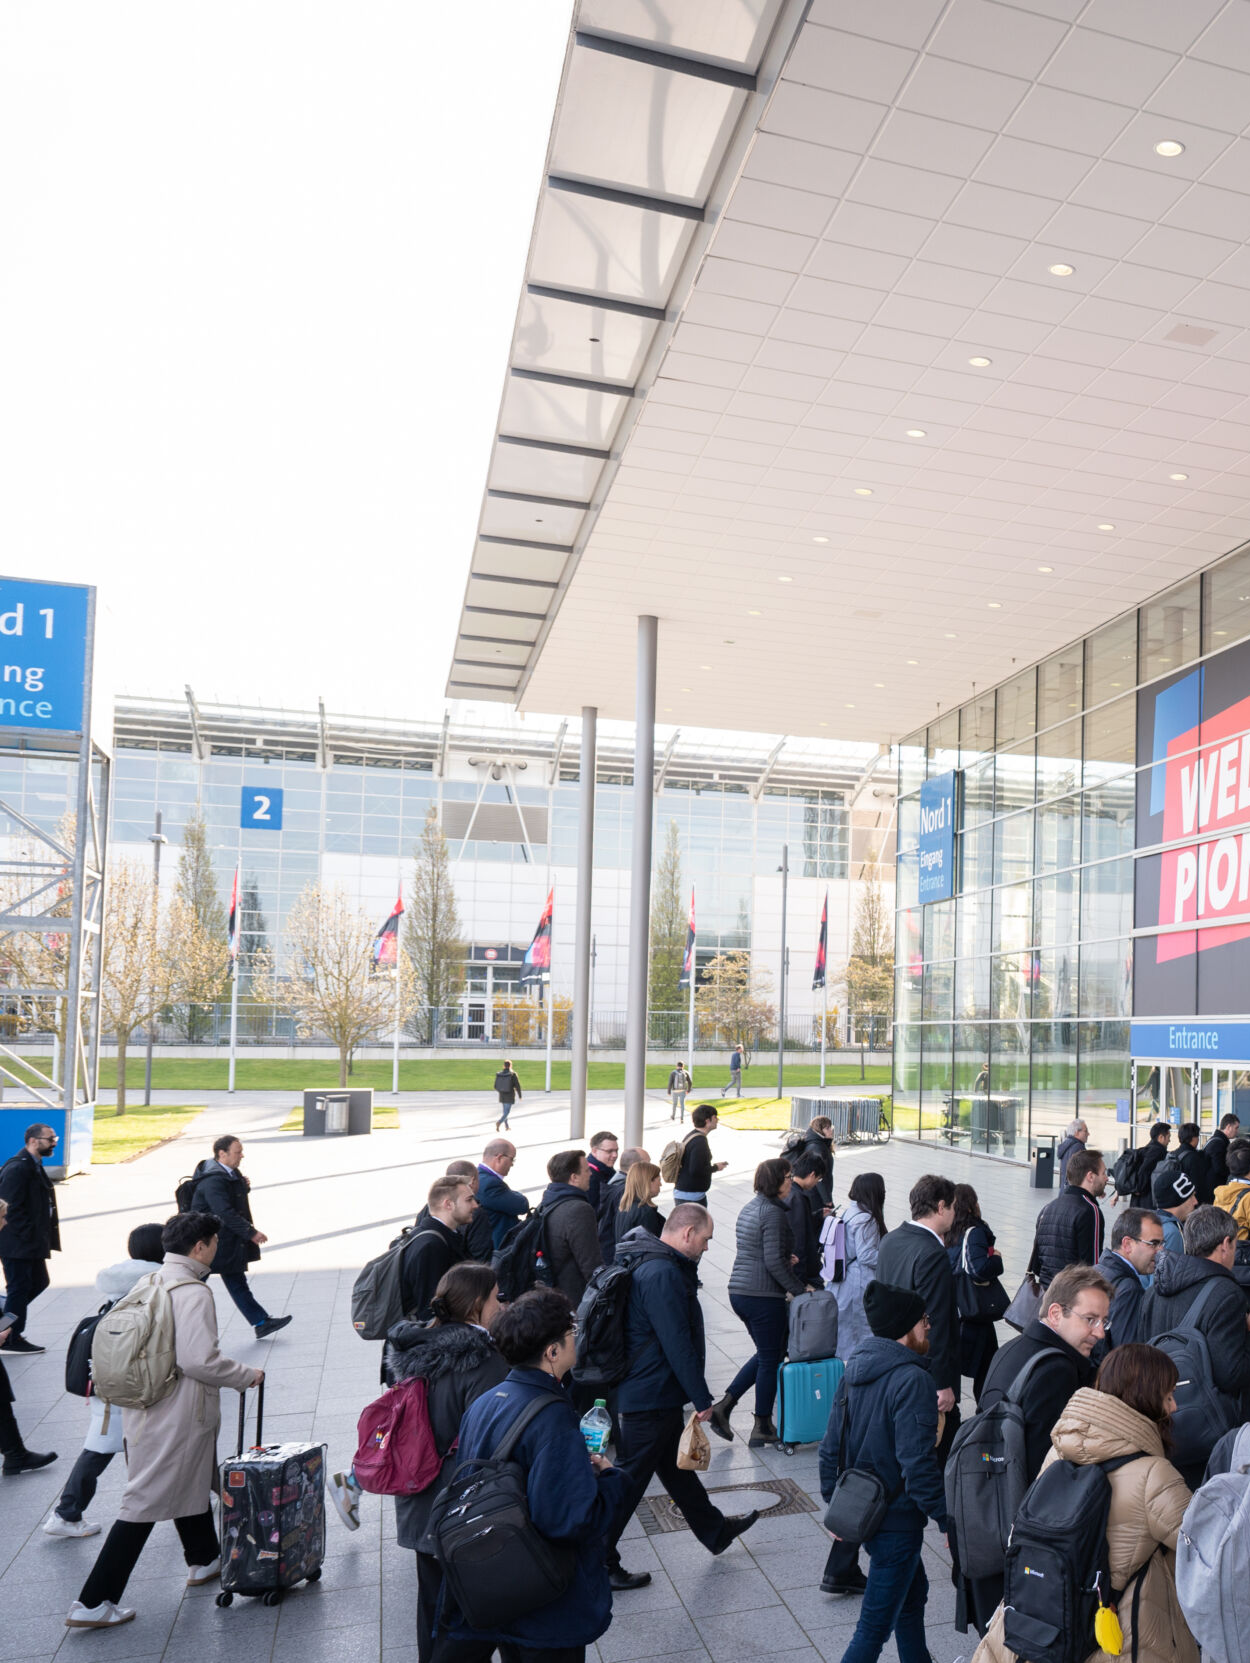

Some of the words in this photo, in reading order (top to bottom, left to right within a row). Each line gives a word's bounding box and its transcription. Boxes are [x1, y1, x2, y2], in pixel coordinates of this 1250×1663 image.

[39, 608, 54, 639] 1
[253, 795, 271, 820] 2
[920, 797, 945, 835] Nord
[946, 797, 951, 827] 1
[920, 849, 944, 871] Eingang
[1168, 1026, 1219, 1049] Entrance
